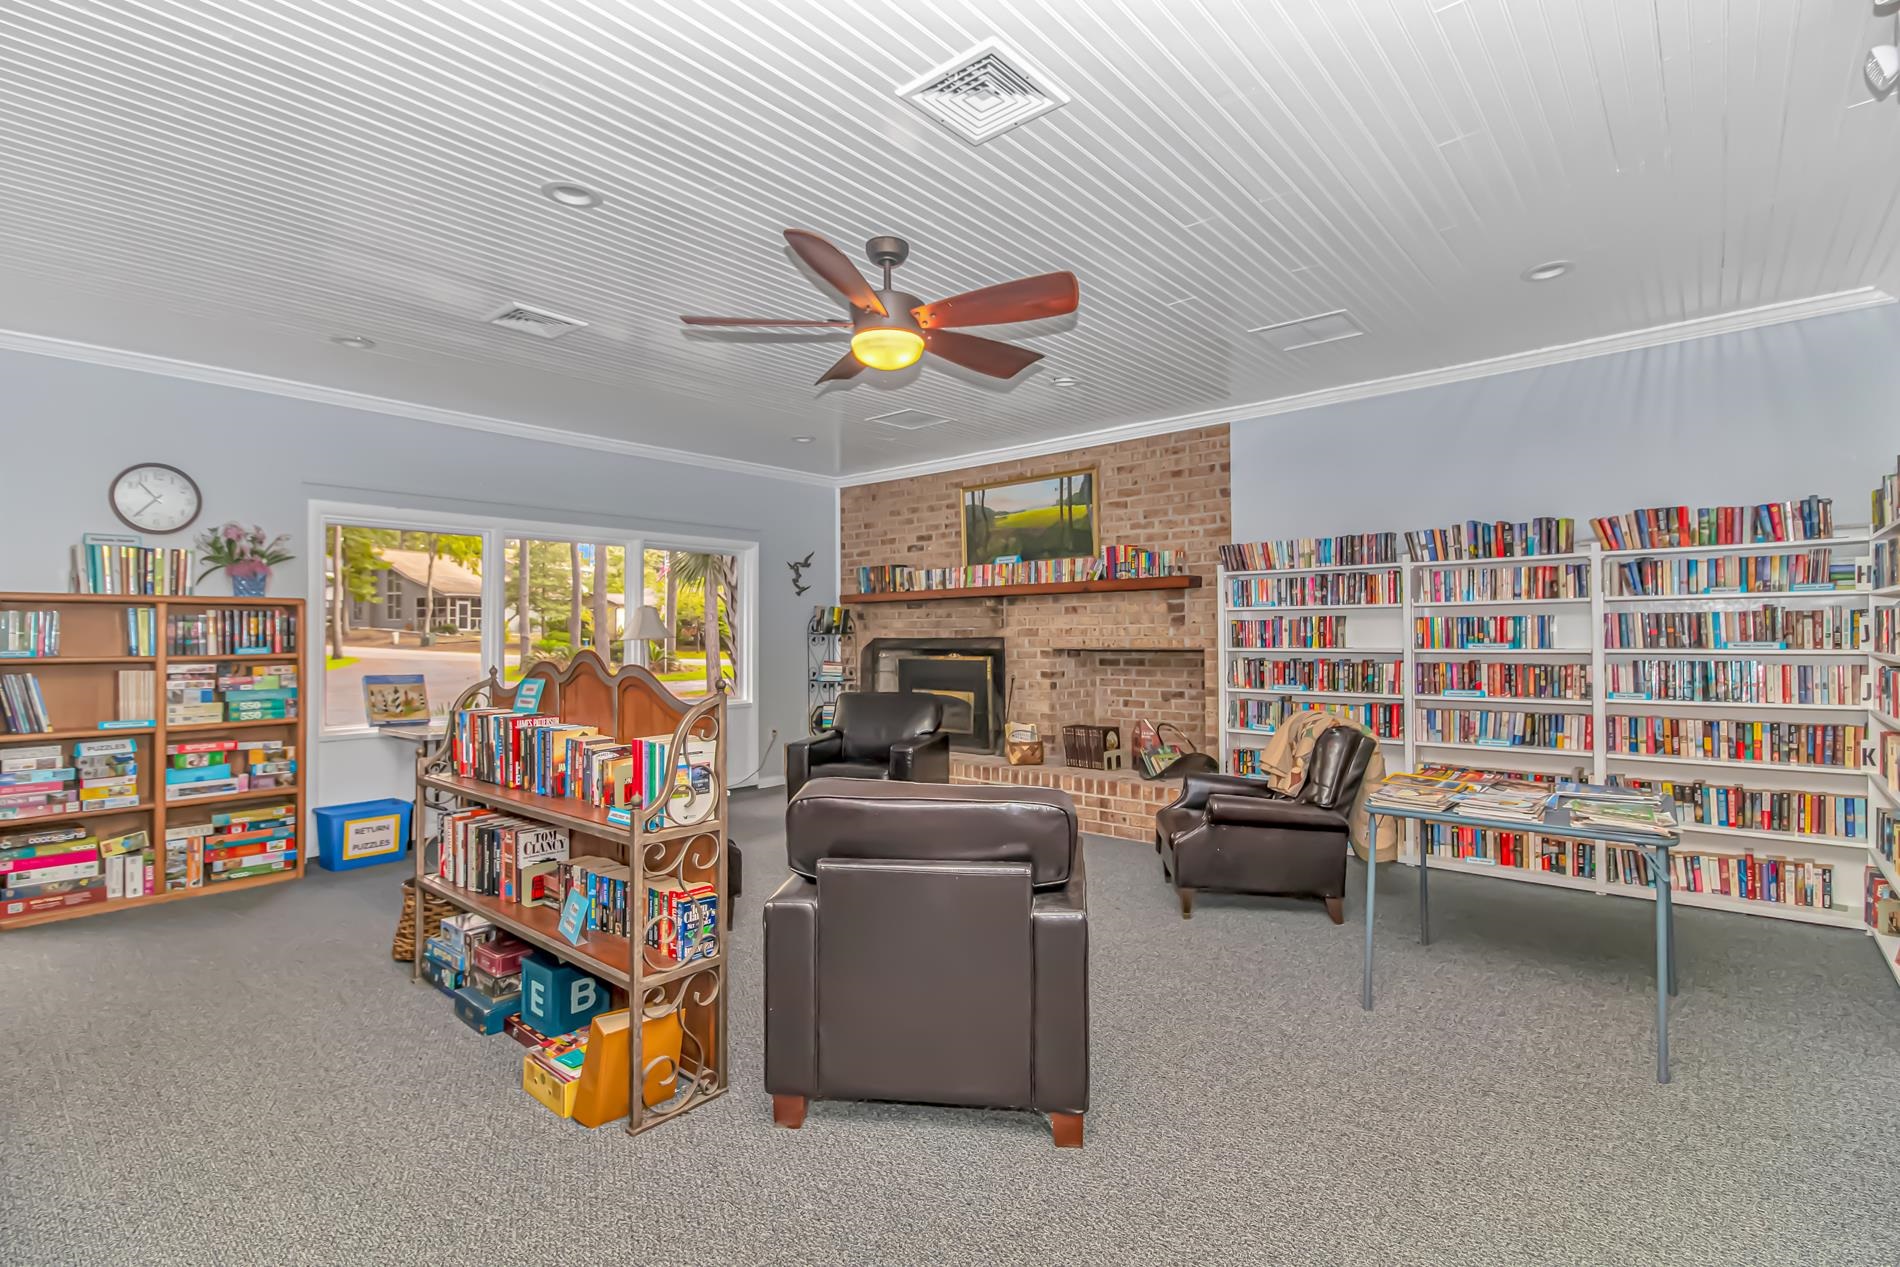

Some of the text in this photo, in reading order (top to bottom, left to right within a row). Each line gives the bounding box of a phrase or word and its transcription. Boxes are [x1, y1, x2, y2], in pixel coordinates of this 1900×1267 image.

[1857, 565, 1872, 584] H
[1861, 624, 1870, 643] J
[1862, 682, 1872, 701] J
[516, 718, 533, 728] JAMES
[87, 743, 127, 752] PUZZLES
[1862, 747, 1877, 766] K
[354, 824, 390, 835] RETURN
[533, 830, 557, 843] TOM
[352, 839, 391, 851] PUZZLES
[523, 839, 565, 855] CLANCY
[530, 979, 545, 1018] E
[570, 976, 597, 1015] B
